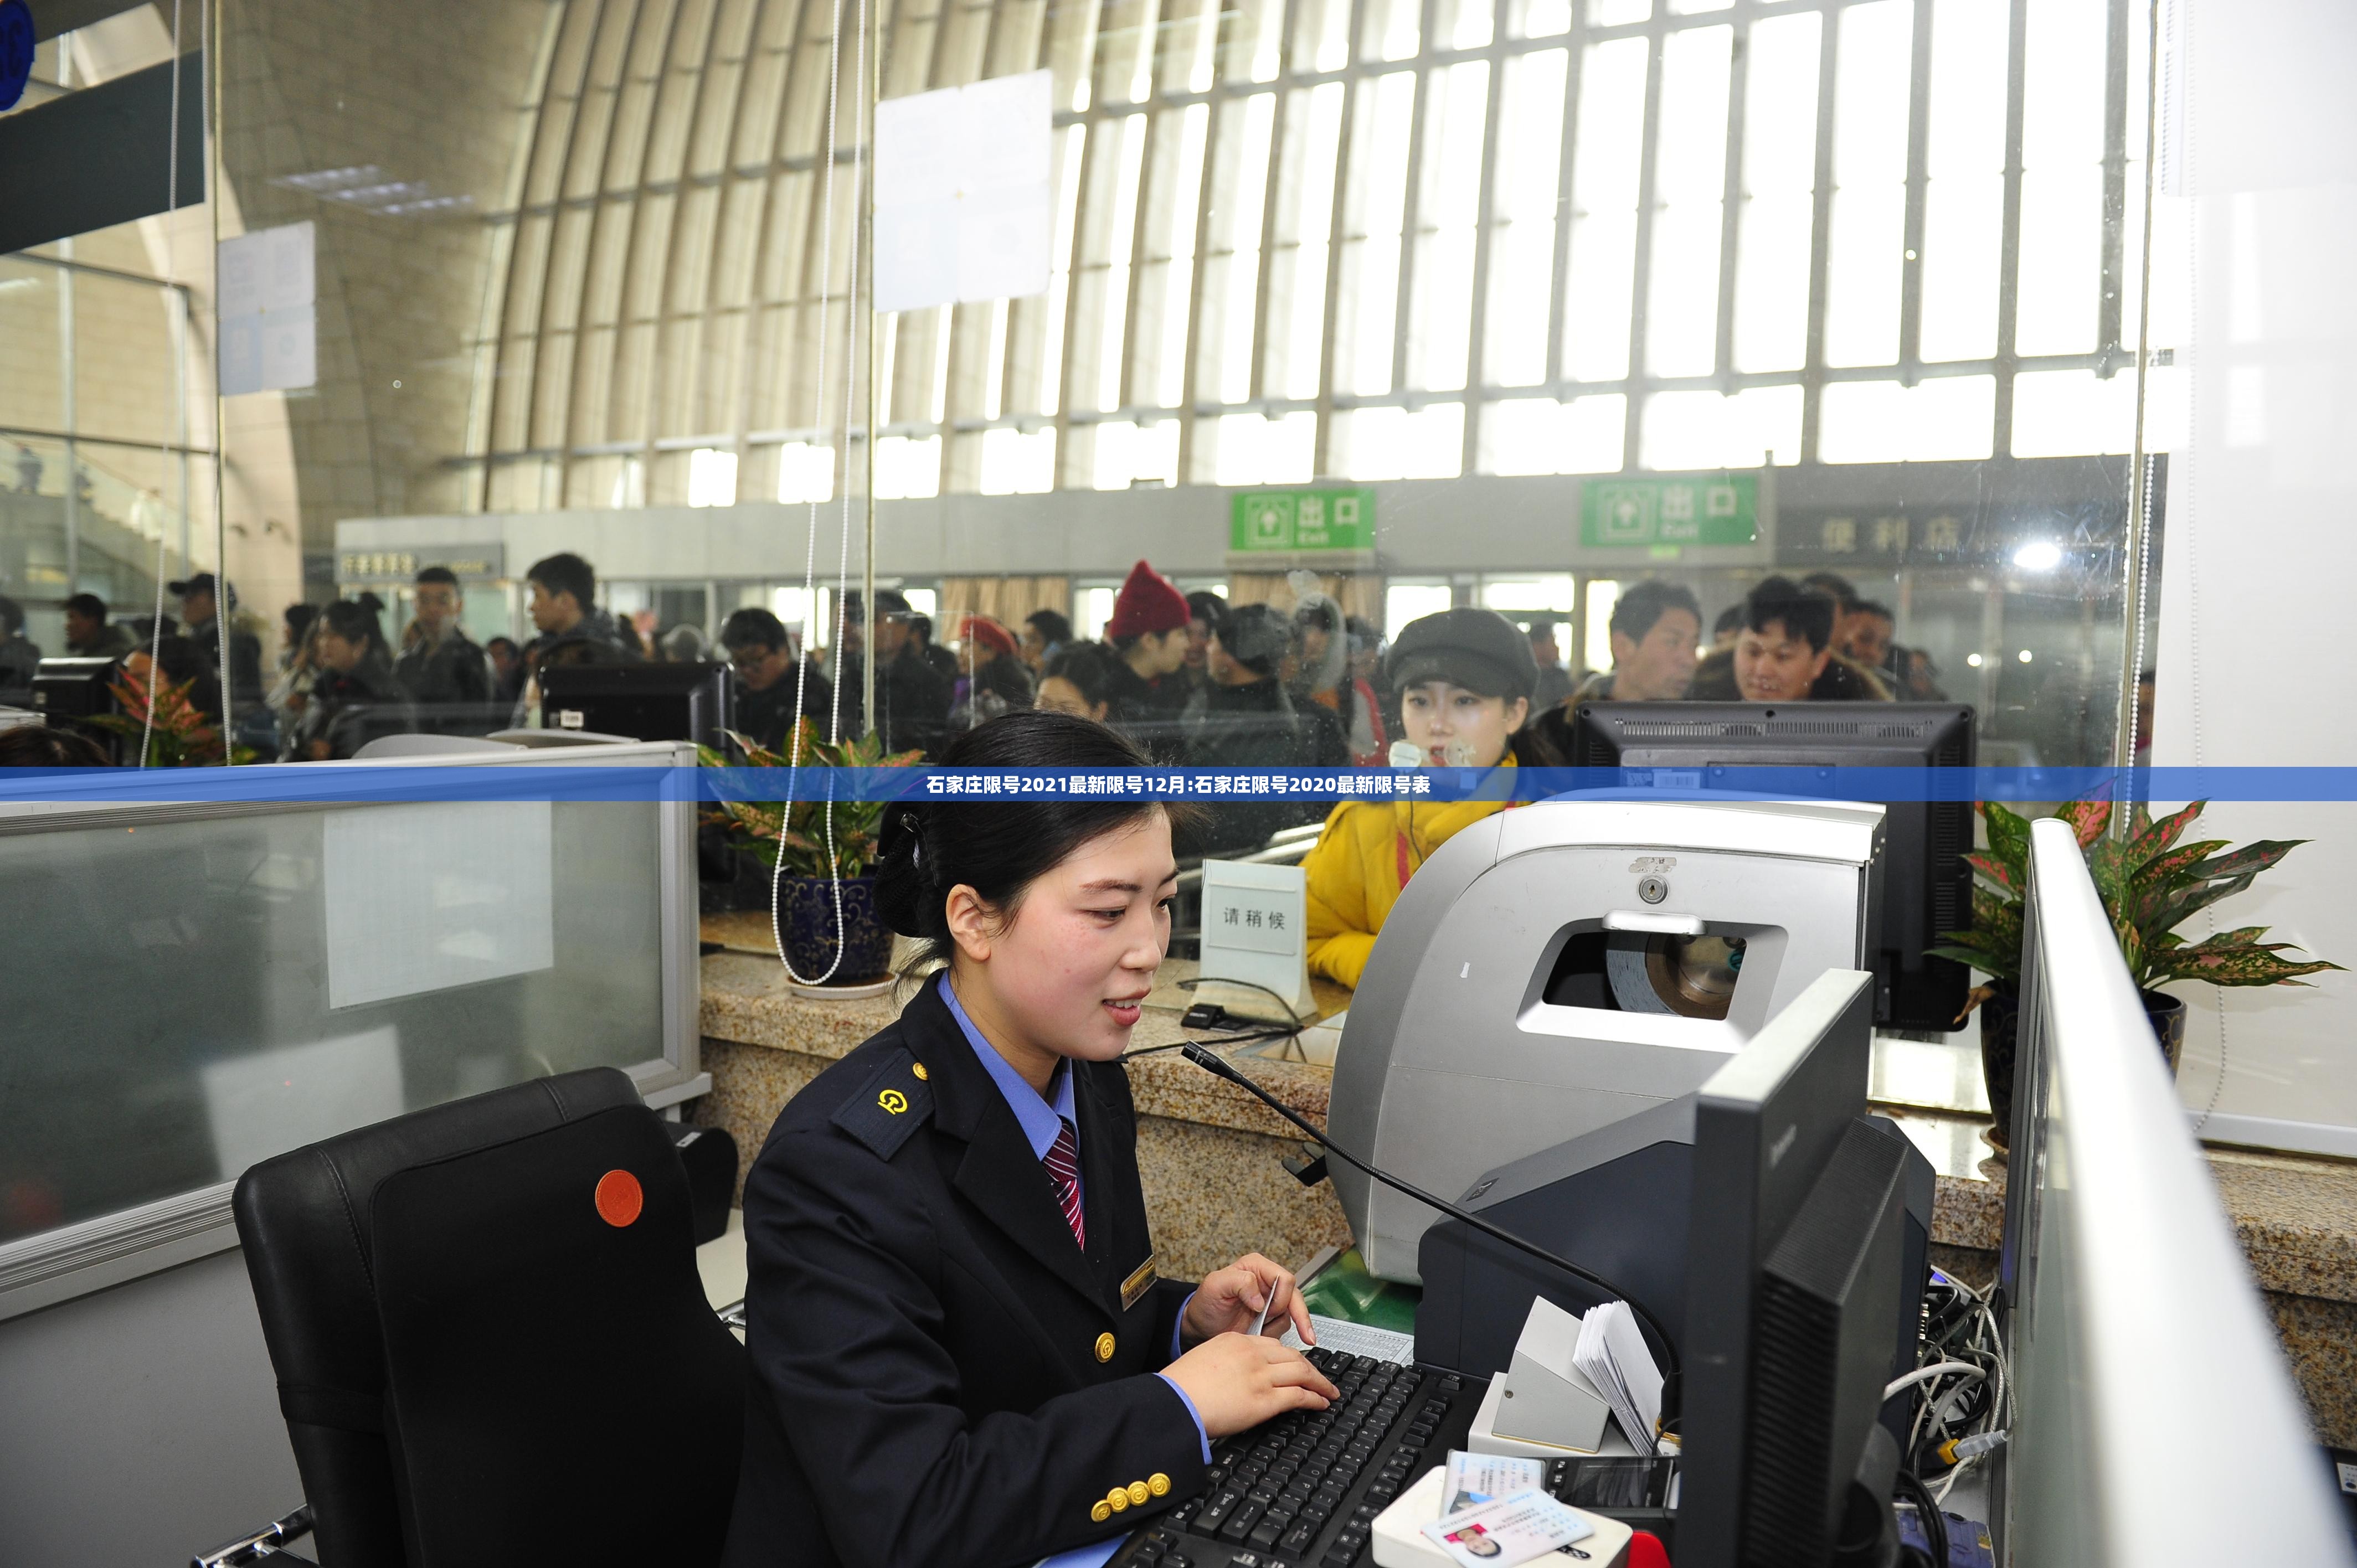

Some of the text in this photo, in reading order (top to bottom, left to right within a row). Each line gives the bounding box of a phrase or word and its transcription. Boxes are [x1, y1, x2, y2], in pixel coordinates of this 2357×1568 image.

[1299, 496, 1360, 526] 出口
[1663, 484, 1737, 518] 出口
[1823, 517, 1960, 553] 便利店
[1224, 907, 1285, 930] 请稍候
